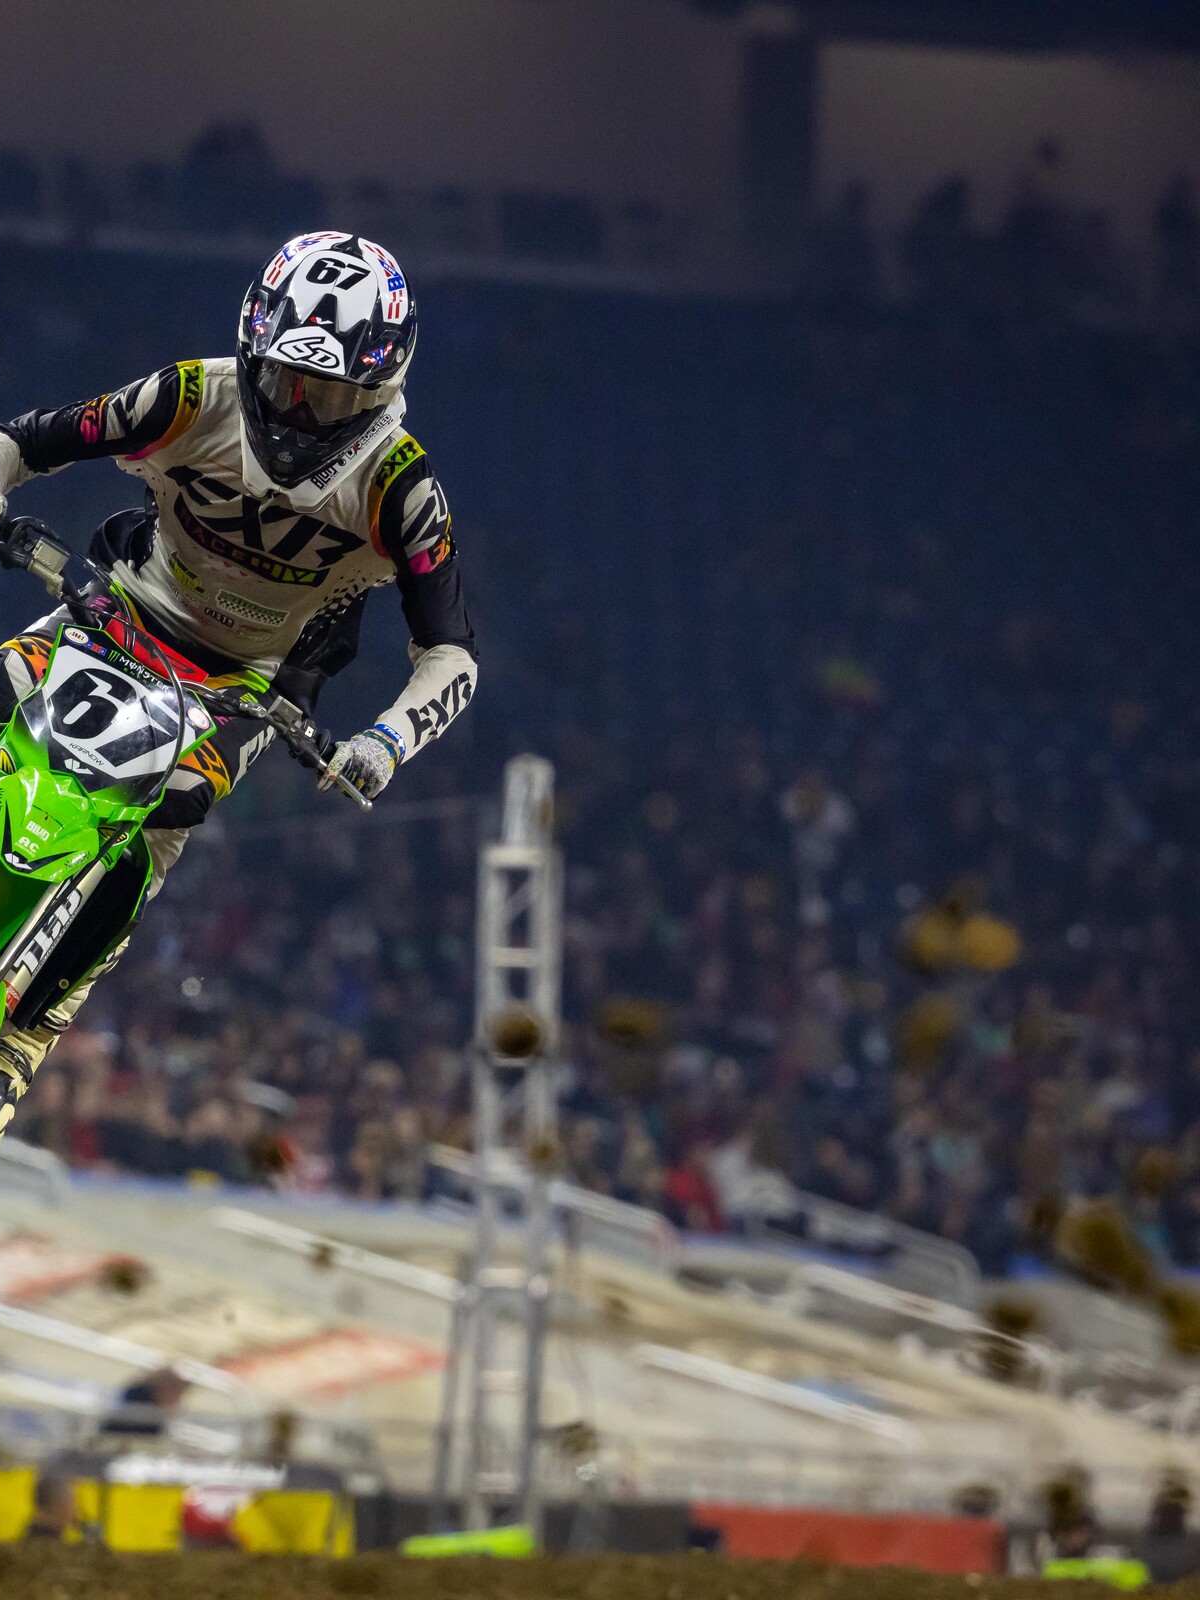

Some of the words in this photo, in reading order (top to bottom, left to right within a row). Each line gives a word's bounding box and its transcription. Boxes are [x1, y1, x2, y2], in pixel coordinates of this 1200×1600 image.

[306, 257, 371, 290] 67
[277, 336, 339, 369] 6D
[376, 441, 418, 491] FXR
[164, 465, 367, 568] FXR
